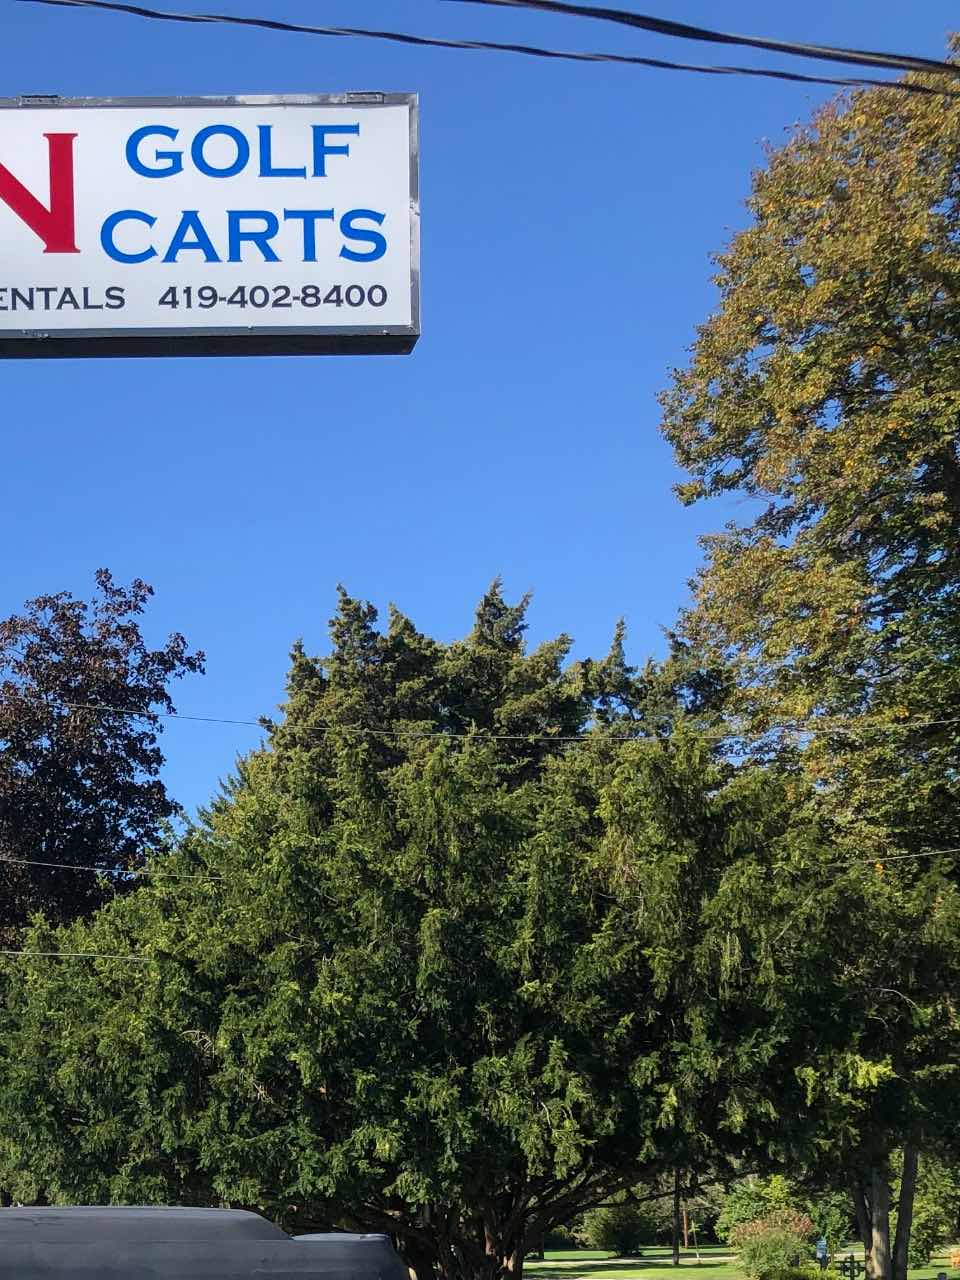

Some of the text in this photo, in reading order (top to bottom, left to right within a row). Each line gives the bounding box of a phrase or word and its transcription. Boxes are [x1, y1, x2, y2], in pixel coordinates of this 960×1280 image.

[125, 122, 360, 179] GOLF
[100, 208, 387, 264] CARTS
[158, 284, 388, 309] 419-402-8400
